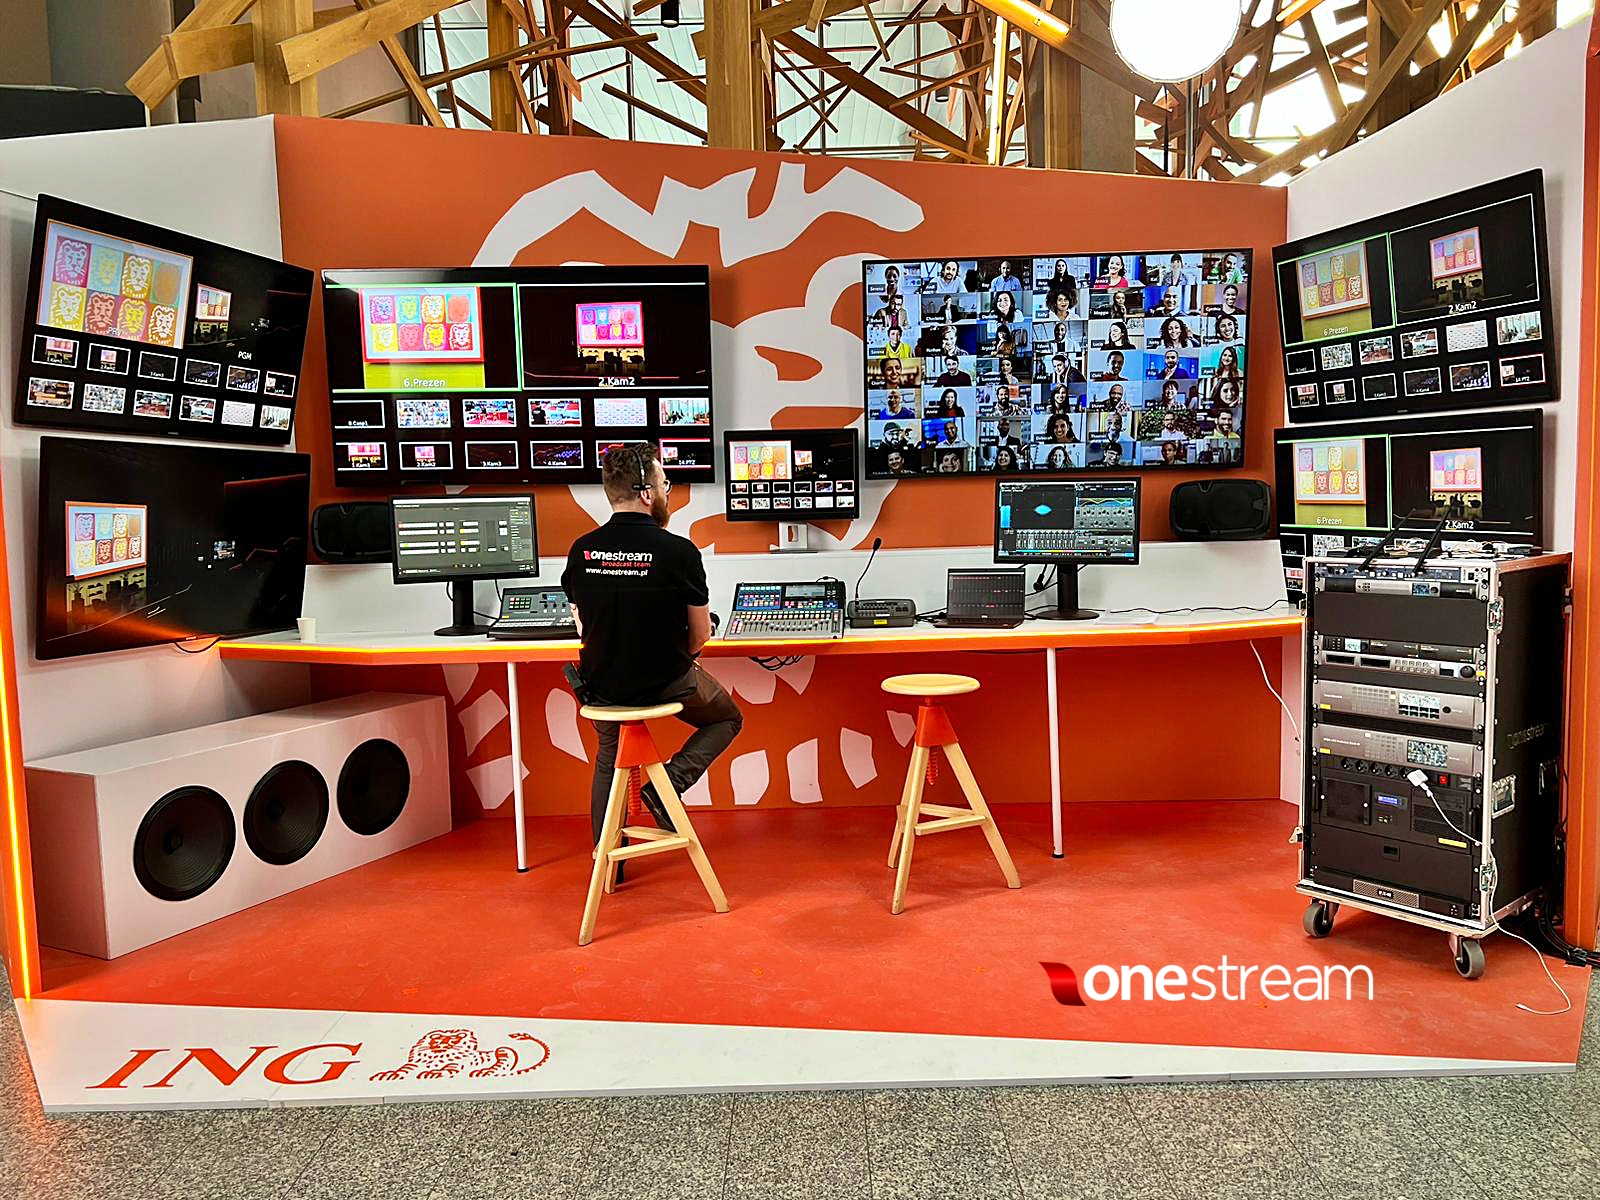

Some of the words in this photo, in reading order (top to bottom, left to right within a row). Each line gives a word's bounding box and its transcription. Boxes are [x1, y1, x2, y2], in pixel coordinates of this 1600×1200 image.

[1448, 300, 1477, 314] 2.Kam2
[1323, 326, 1348, 336] 6.Prezen
[238, 350, 252, 360] PGM
[404, 378, 446, 388] 6.Prezen
[598, 377, 636, 386] 2.Kam2
[1316, 516, 1343, 525] 6.Prezen
[1445, 520, 1474, 530] 2.Kam2
[590, 550, 652, 562] onestream
[586, 567, 648, 576] www.onestream.pl
[84, 1042, 363, 1088] ING
